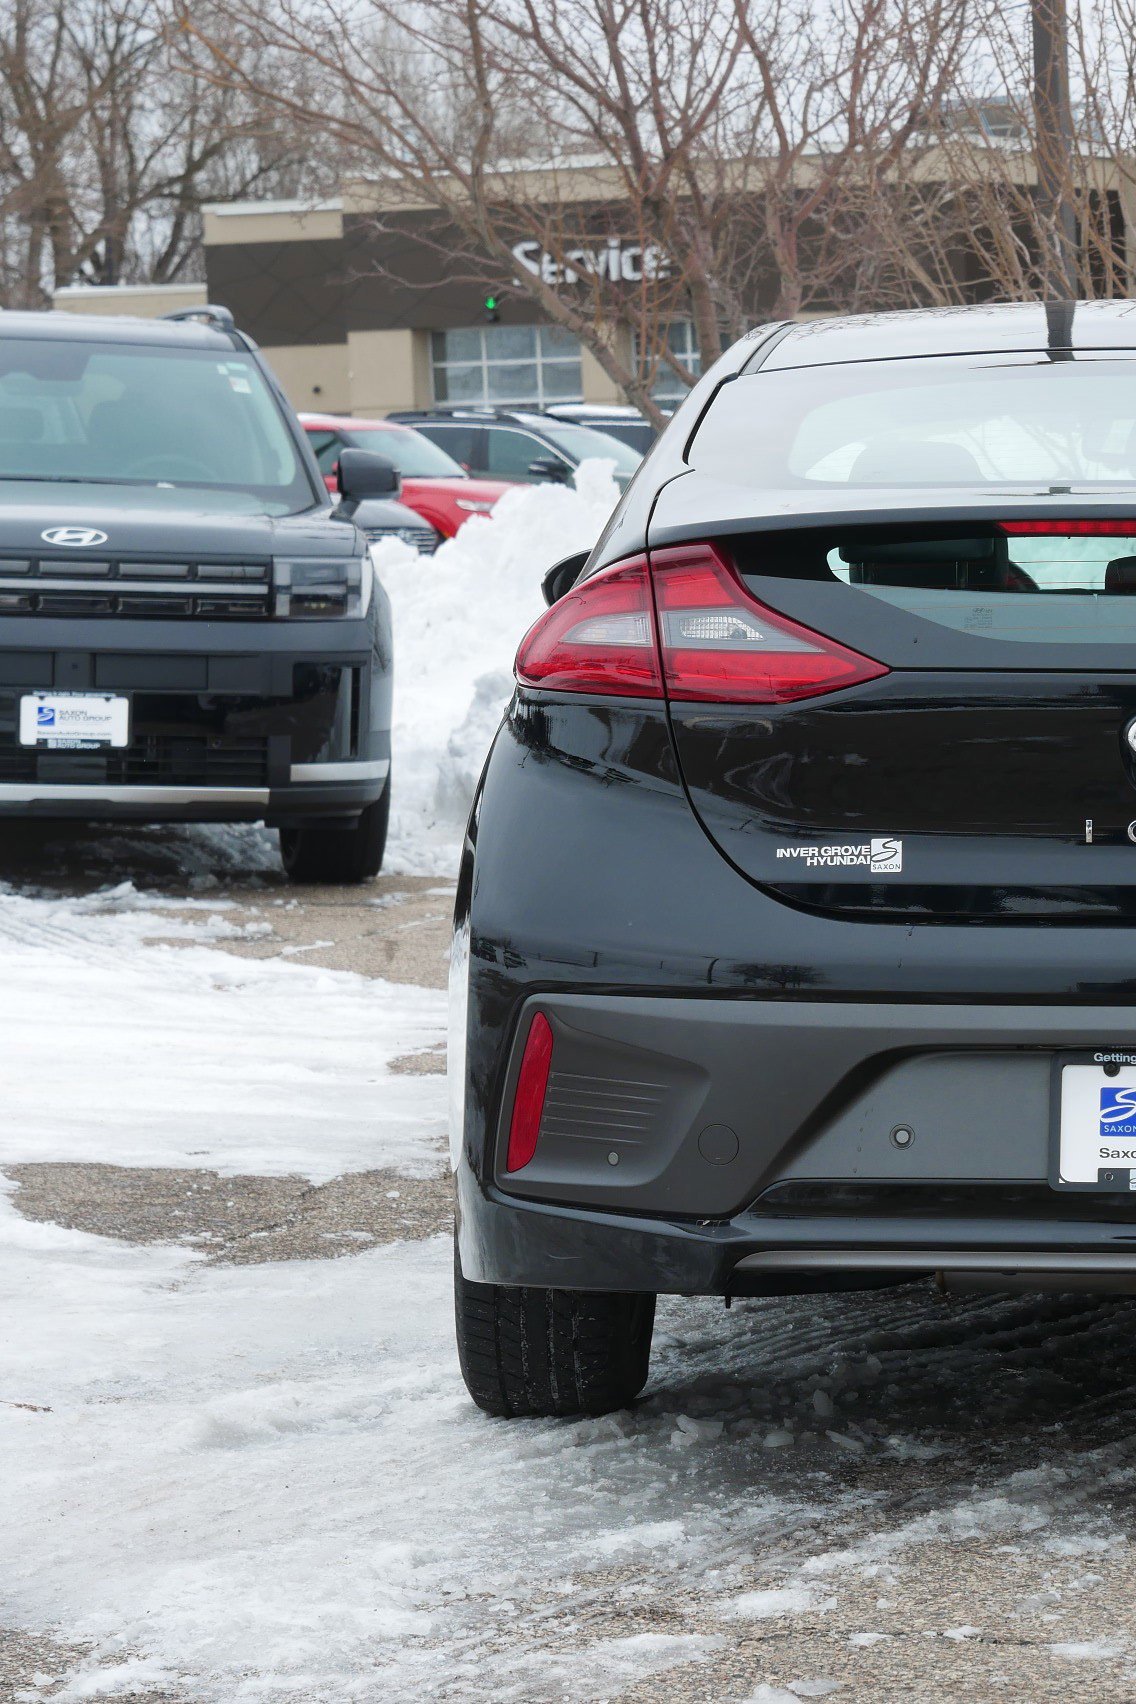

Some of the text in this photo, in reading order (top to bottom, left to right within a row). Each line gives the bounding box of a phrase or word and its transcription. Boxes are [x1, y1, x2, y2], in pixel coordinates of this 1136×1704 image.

[512, 237, 671, 287] Service
[776, 845, 871, 858] INVER GROVE
[806, 855, 871, 866] HYUNDAI
